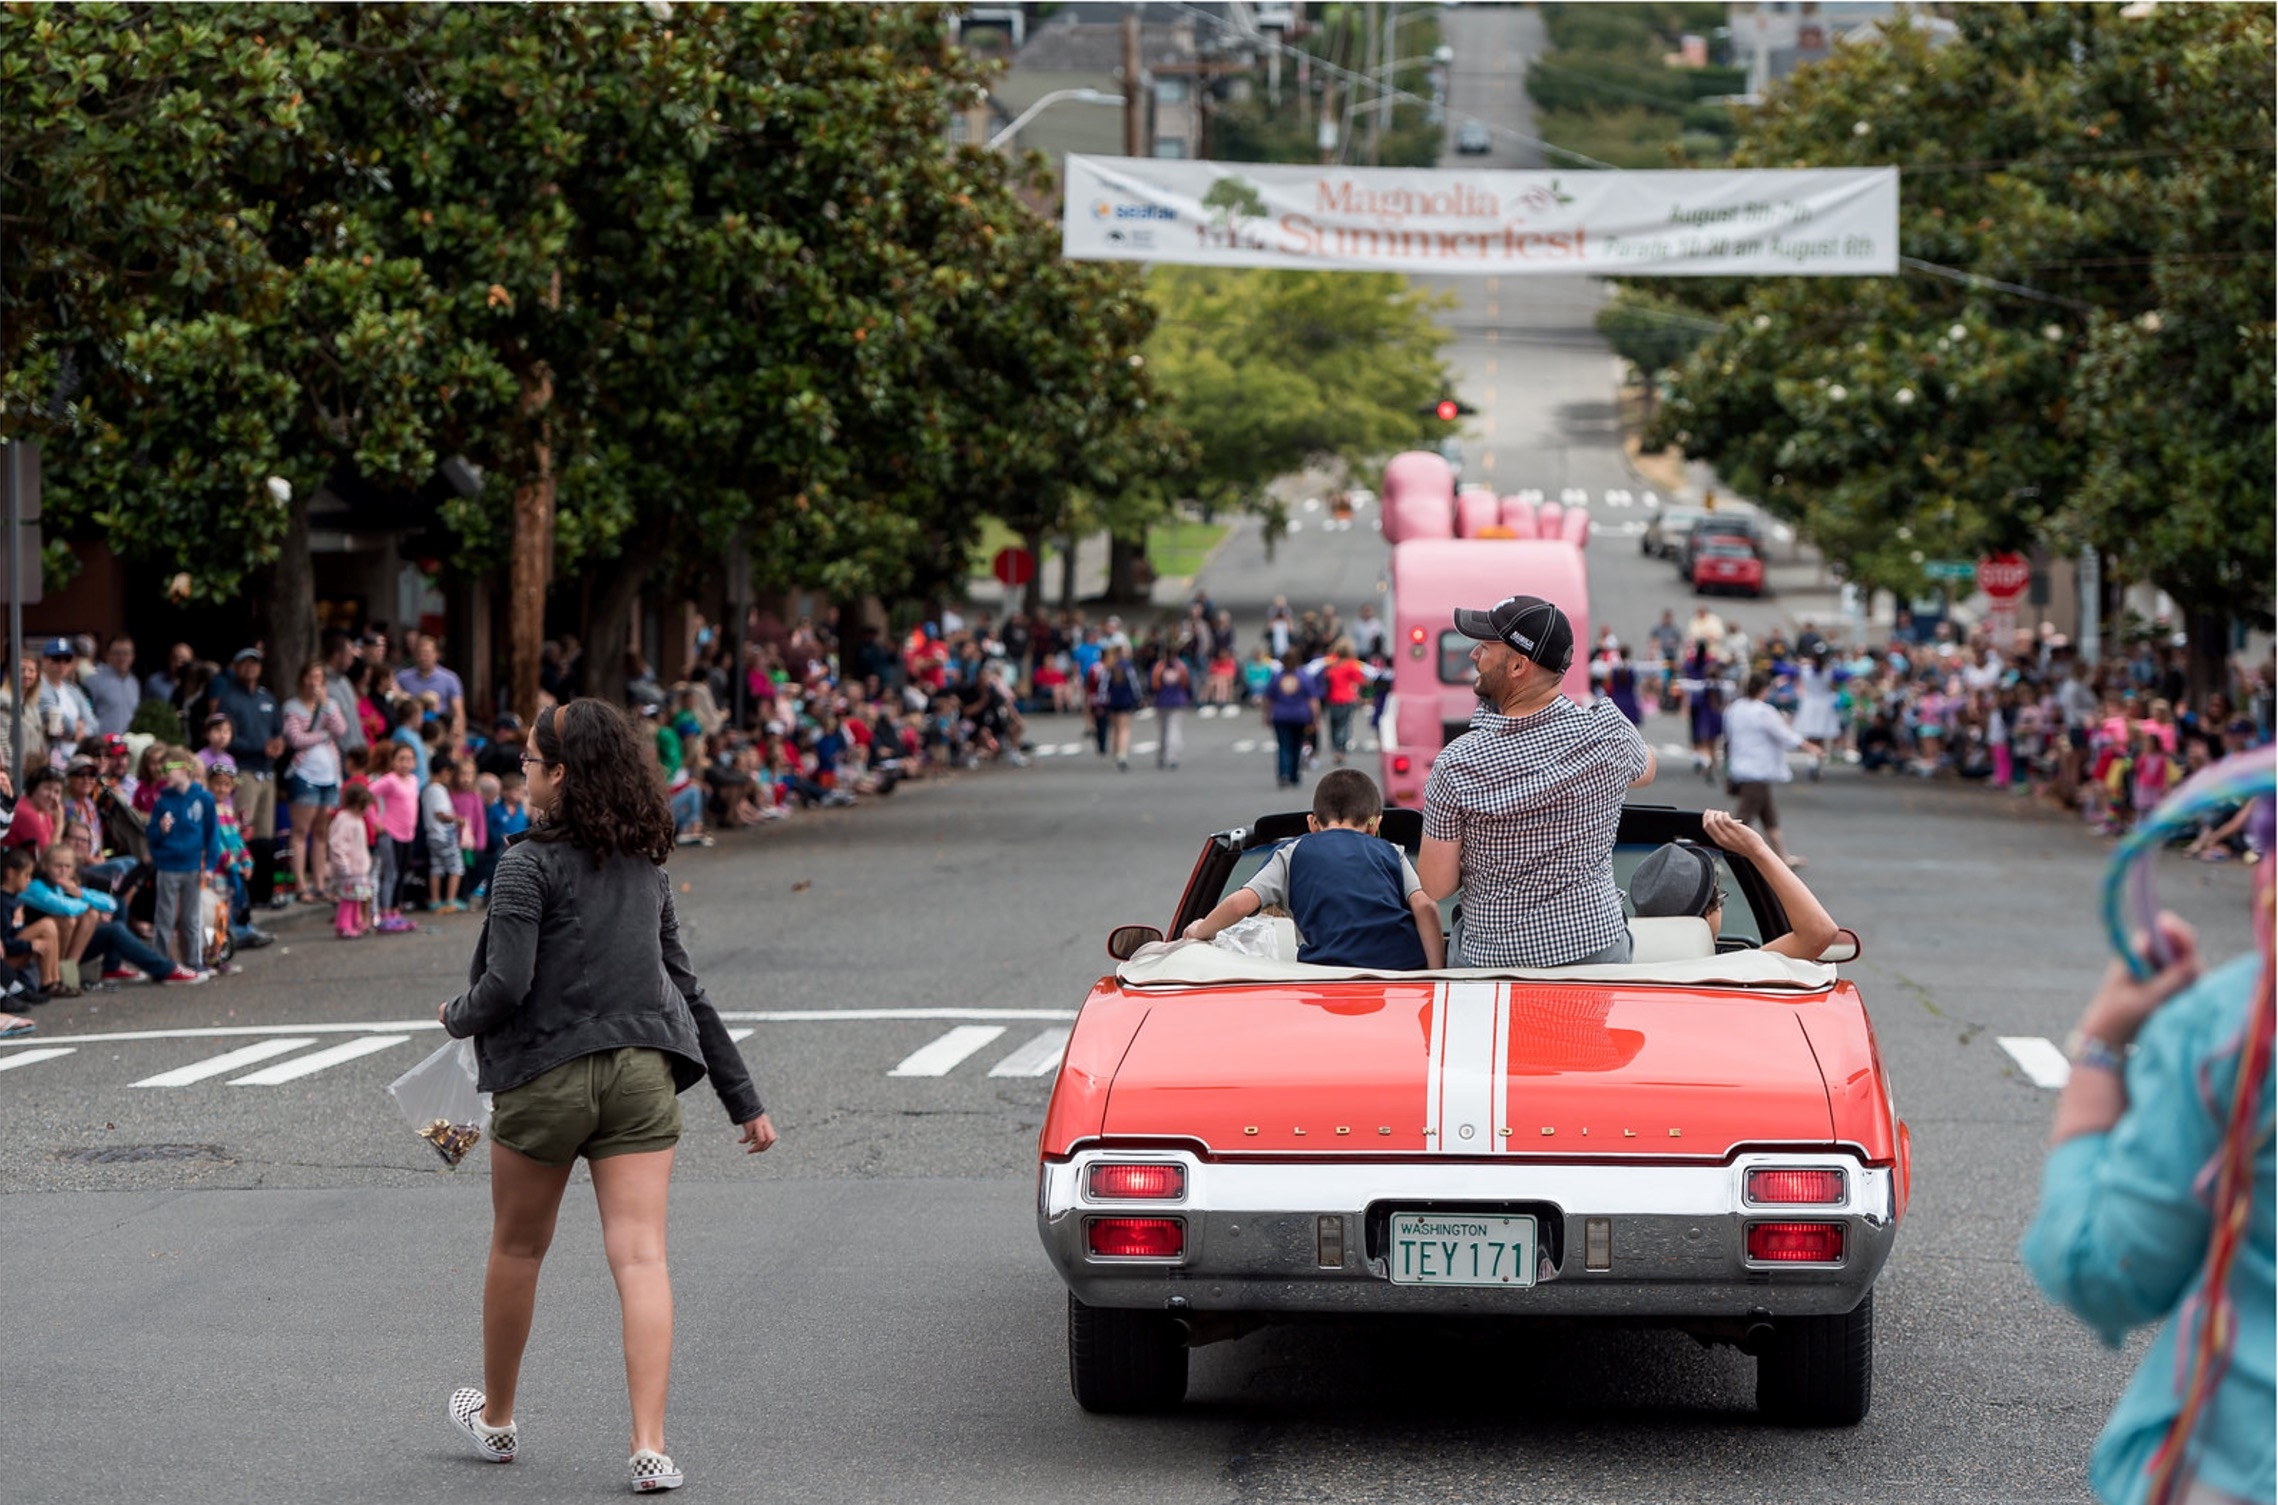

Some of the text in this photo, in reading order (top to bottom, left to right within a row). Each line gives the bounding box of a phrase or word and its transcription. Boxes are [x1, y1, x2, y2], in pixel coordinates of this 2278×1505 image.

[1315, 179, 1500, 223] Magnolia
[1277, 213, 1587, 261] Summerfest
[1769, 233, 1839, 262] August
[1981, 564, 2026, 587] STOP
[1243, 1125, 1682, 1138] OLDSMOBILE
[1401, 1223, 1488, 1237] WASHINGTON
[1399, 1240, 1522, 1278] TEY 171
